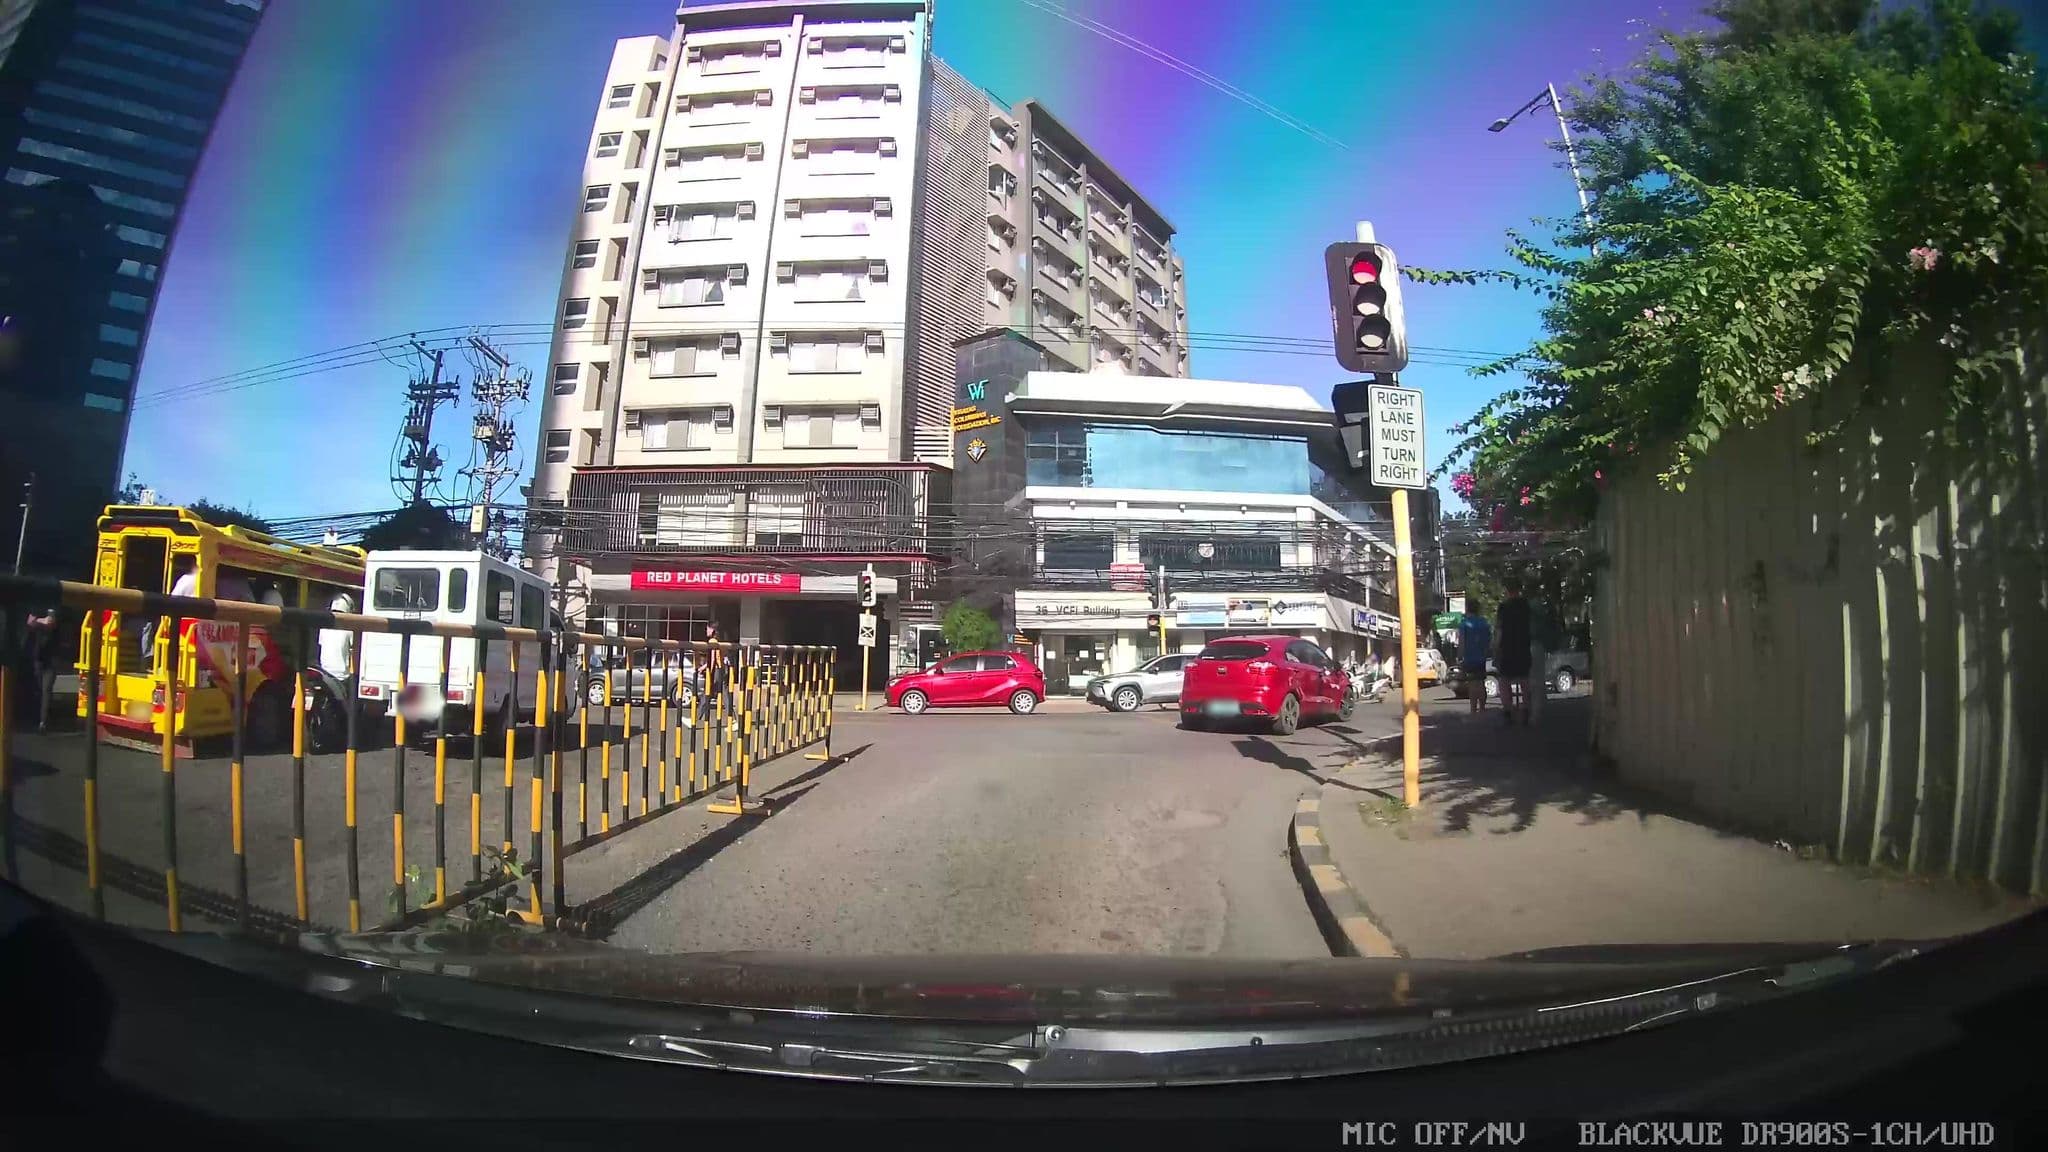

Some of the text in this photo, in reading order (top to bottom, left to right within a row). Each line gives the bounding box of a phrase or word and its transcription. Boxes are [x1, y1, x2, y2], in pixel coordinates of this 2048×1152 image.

[1377, 391, 1415, 407] RIGHT
[1380, 411, 1414, 425] LANE
[1381, 428, 1415, 443] MUST
[1382, 447, 1416, 462] TURN
[1380, 464, 1418, 480] RIGHT
[647, 571, 782, 584] RED PLANET HOTELS
[1083, 605, 1121, 617] Building
